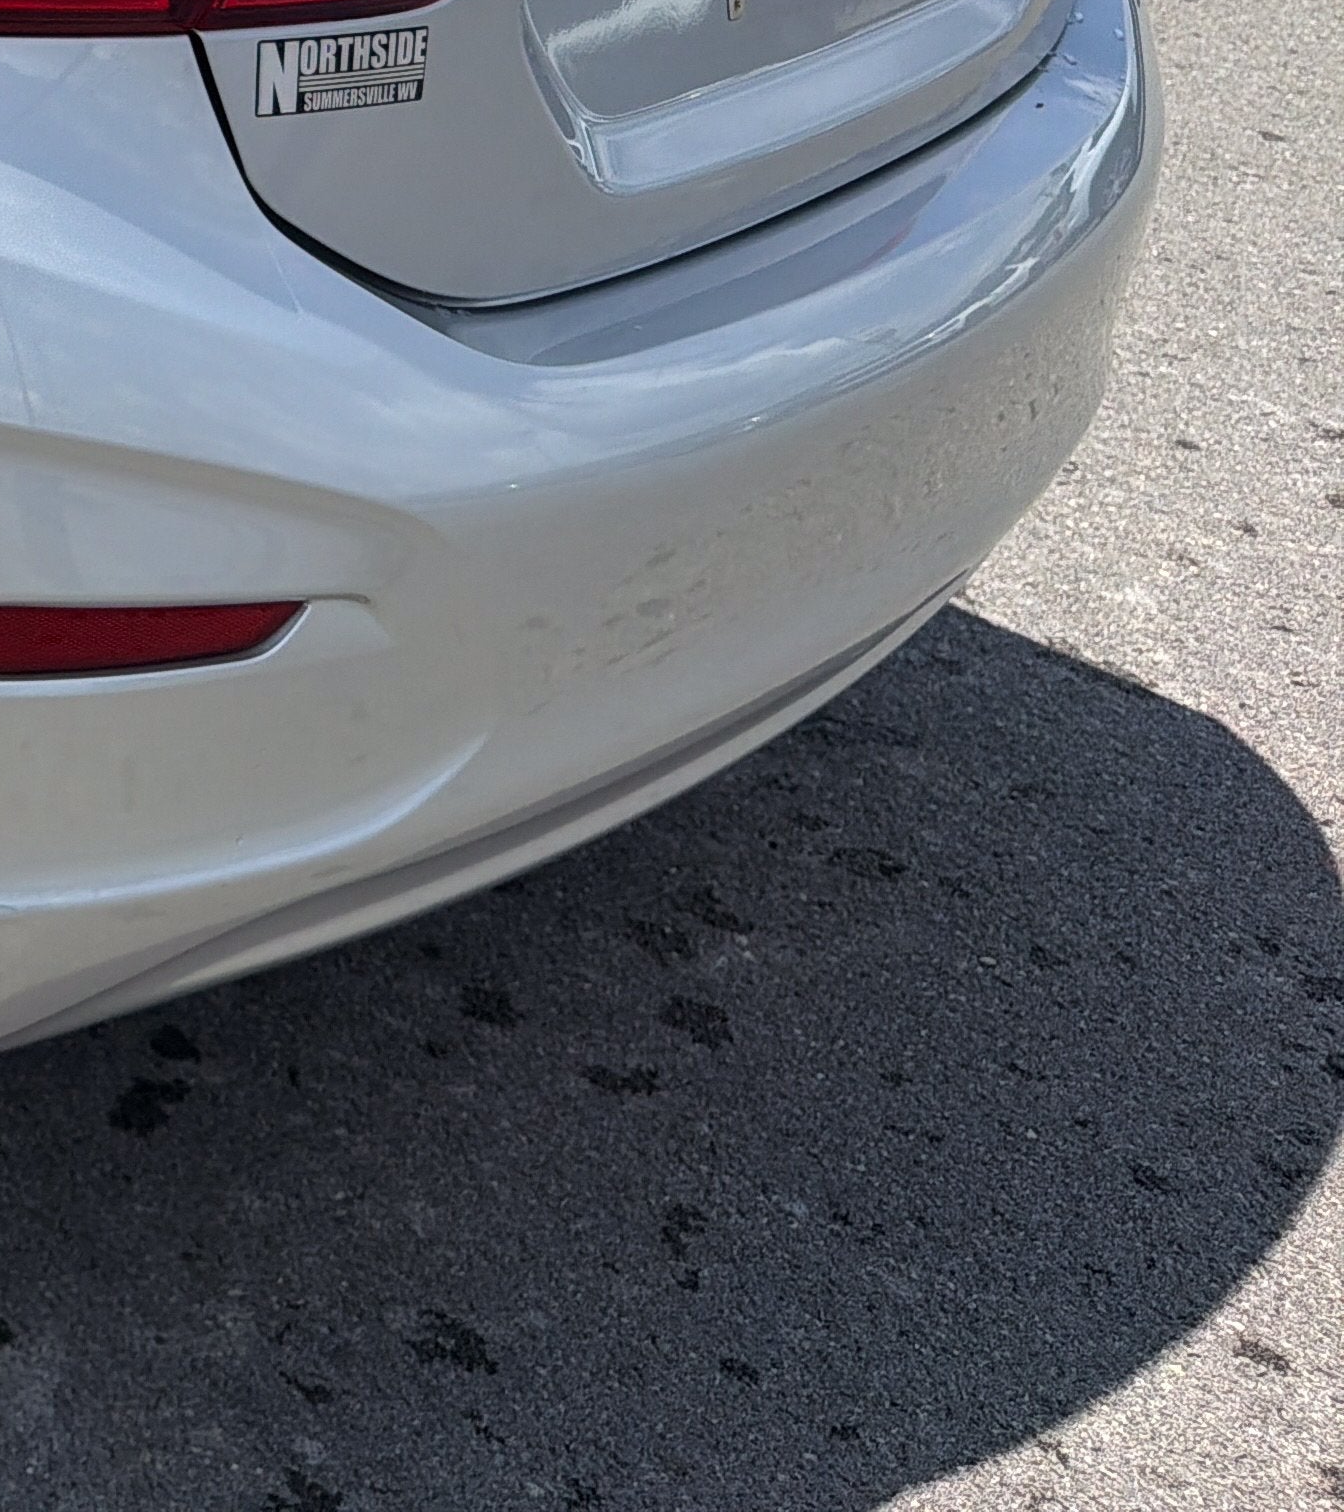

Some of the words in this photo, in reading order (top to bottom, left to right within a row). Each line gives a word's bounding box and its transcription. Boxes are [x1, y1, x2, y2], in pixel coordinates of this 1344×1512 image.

[257, 28, 428, 116] NORTHSIDE
[303, 83, 395, 112] SUMMERSVILLE
[397, 81, 418, 101] WV
